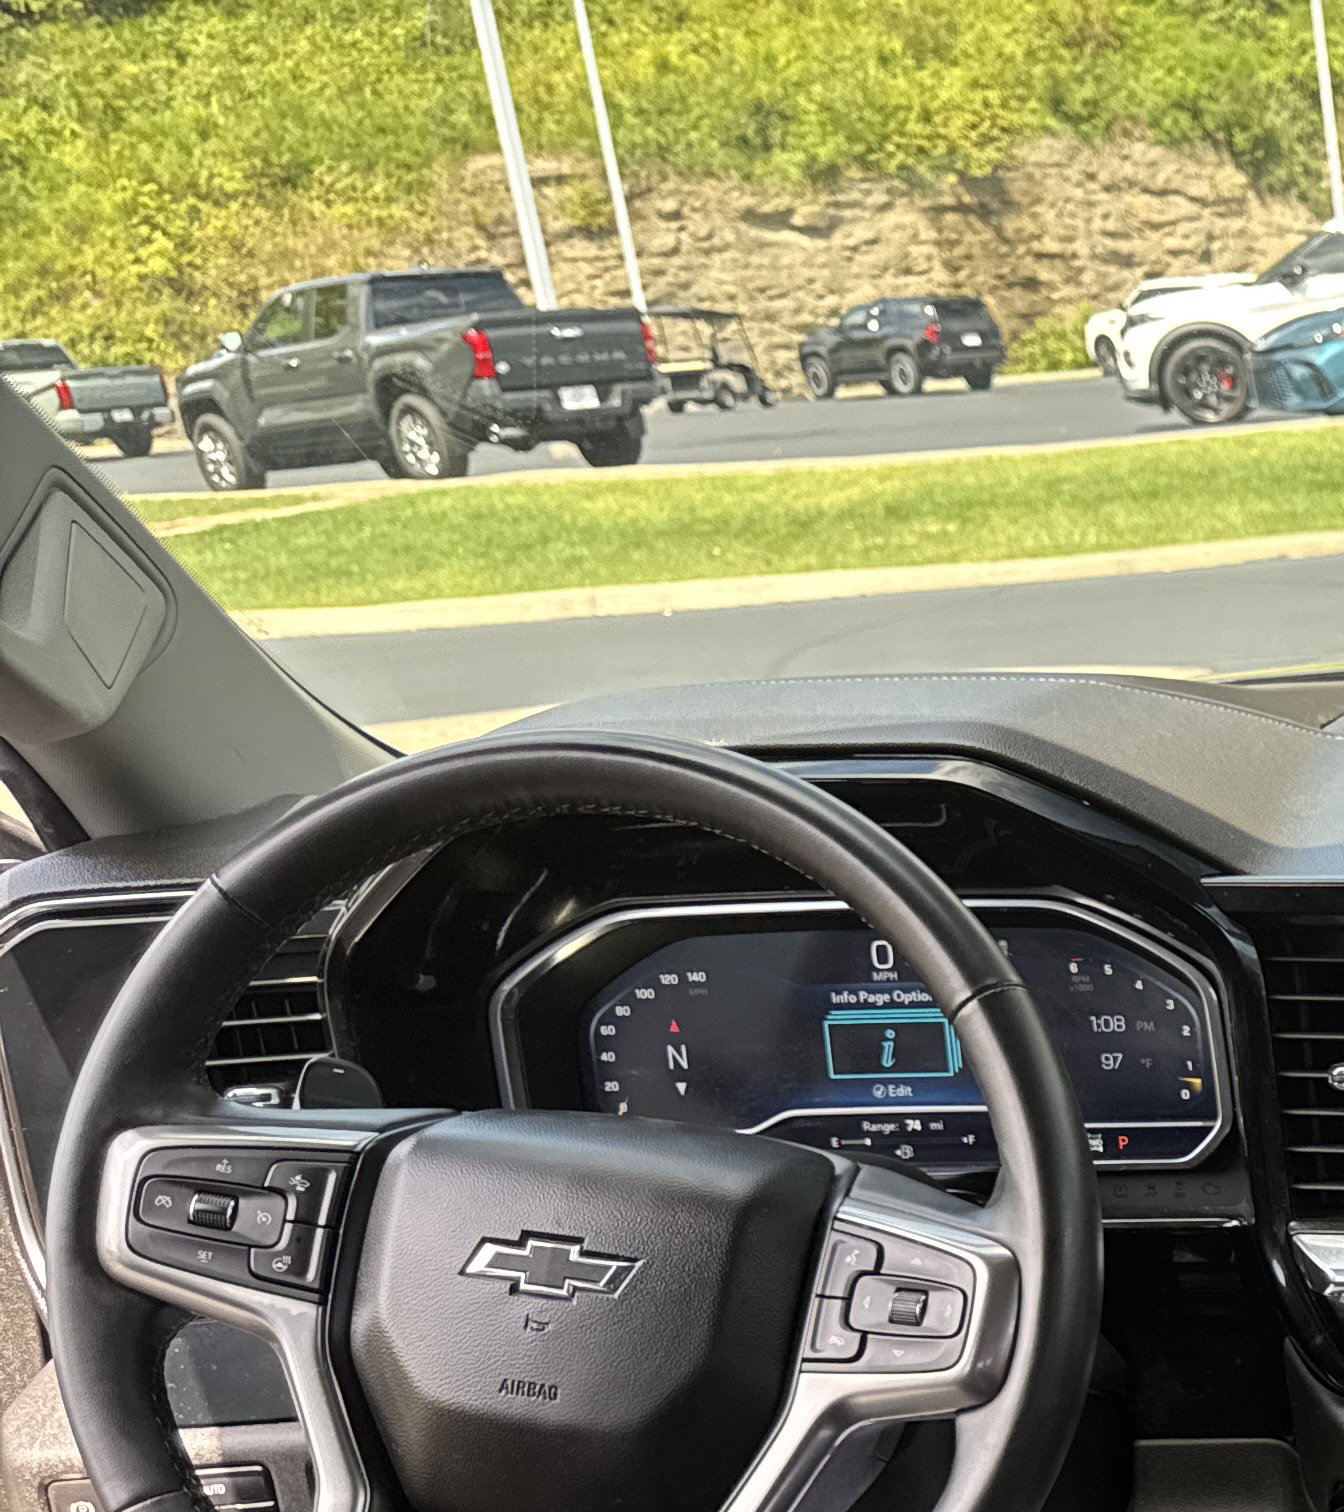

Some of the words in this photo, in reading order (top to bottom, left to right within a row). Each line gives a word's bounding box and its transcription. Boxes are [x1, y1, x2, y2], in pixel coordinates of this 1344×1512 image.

[870, 940, 894, 969] 0
[1069, 962, 1079, 973] 6
[1103, 964, 1113, 975] 5
[659, 974, 679, 985] 120
[687, 971, 707, 983] 140
[872, 971, 898, 981] MPH
[1134, 979, 1144, 991] 4
[634, 988, 655, 999] 100
[830, 991, 857, 1003] Info
[860, 990, 891, 1006] Page
[893, 989, 933, 1005] Optio
[615, 1005, 631, 1016] 80
[1165, 999, 1175, 1011] 3
[1089, 1015, 1126, 1032] 1:08
[1136, 1020, 1155, 1032] PM
[600, 1025, 616, 1036] 60
[1181, 1025, 1191, 1037] 2
[600, 1052, 616, 1063] 40
[666, 1043, 689, 1070] N
[1101, 1052, 1124, 1070] 97
[1186, 1060, 1193, 1071] 1
[604, 1081, 620, 1092] 20
[888, 1084, 913, 1097] Edit
[862, 1121, 899, 1134] Range:
[929, 1120, 944, 1131] mi
[1117, 1135, 1129, 1150] P
[198, 1250, 213, 1260] SET
[498, 1378, 559, 1401] AIRBAG
